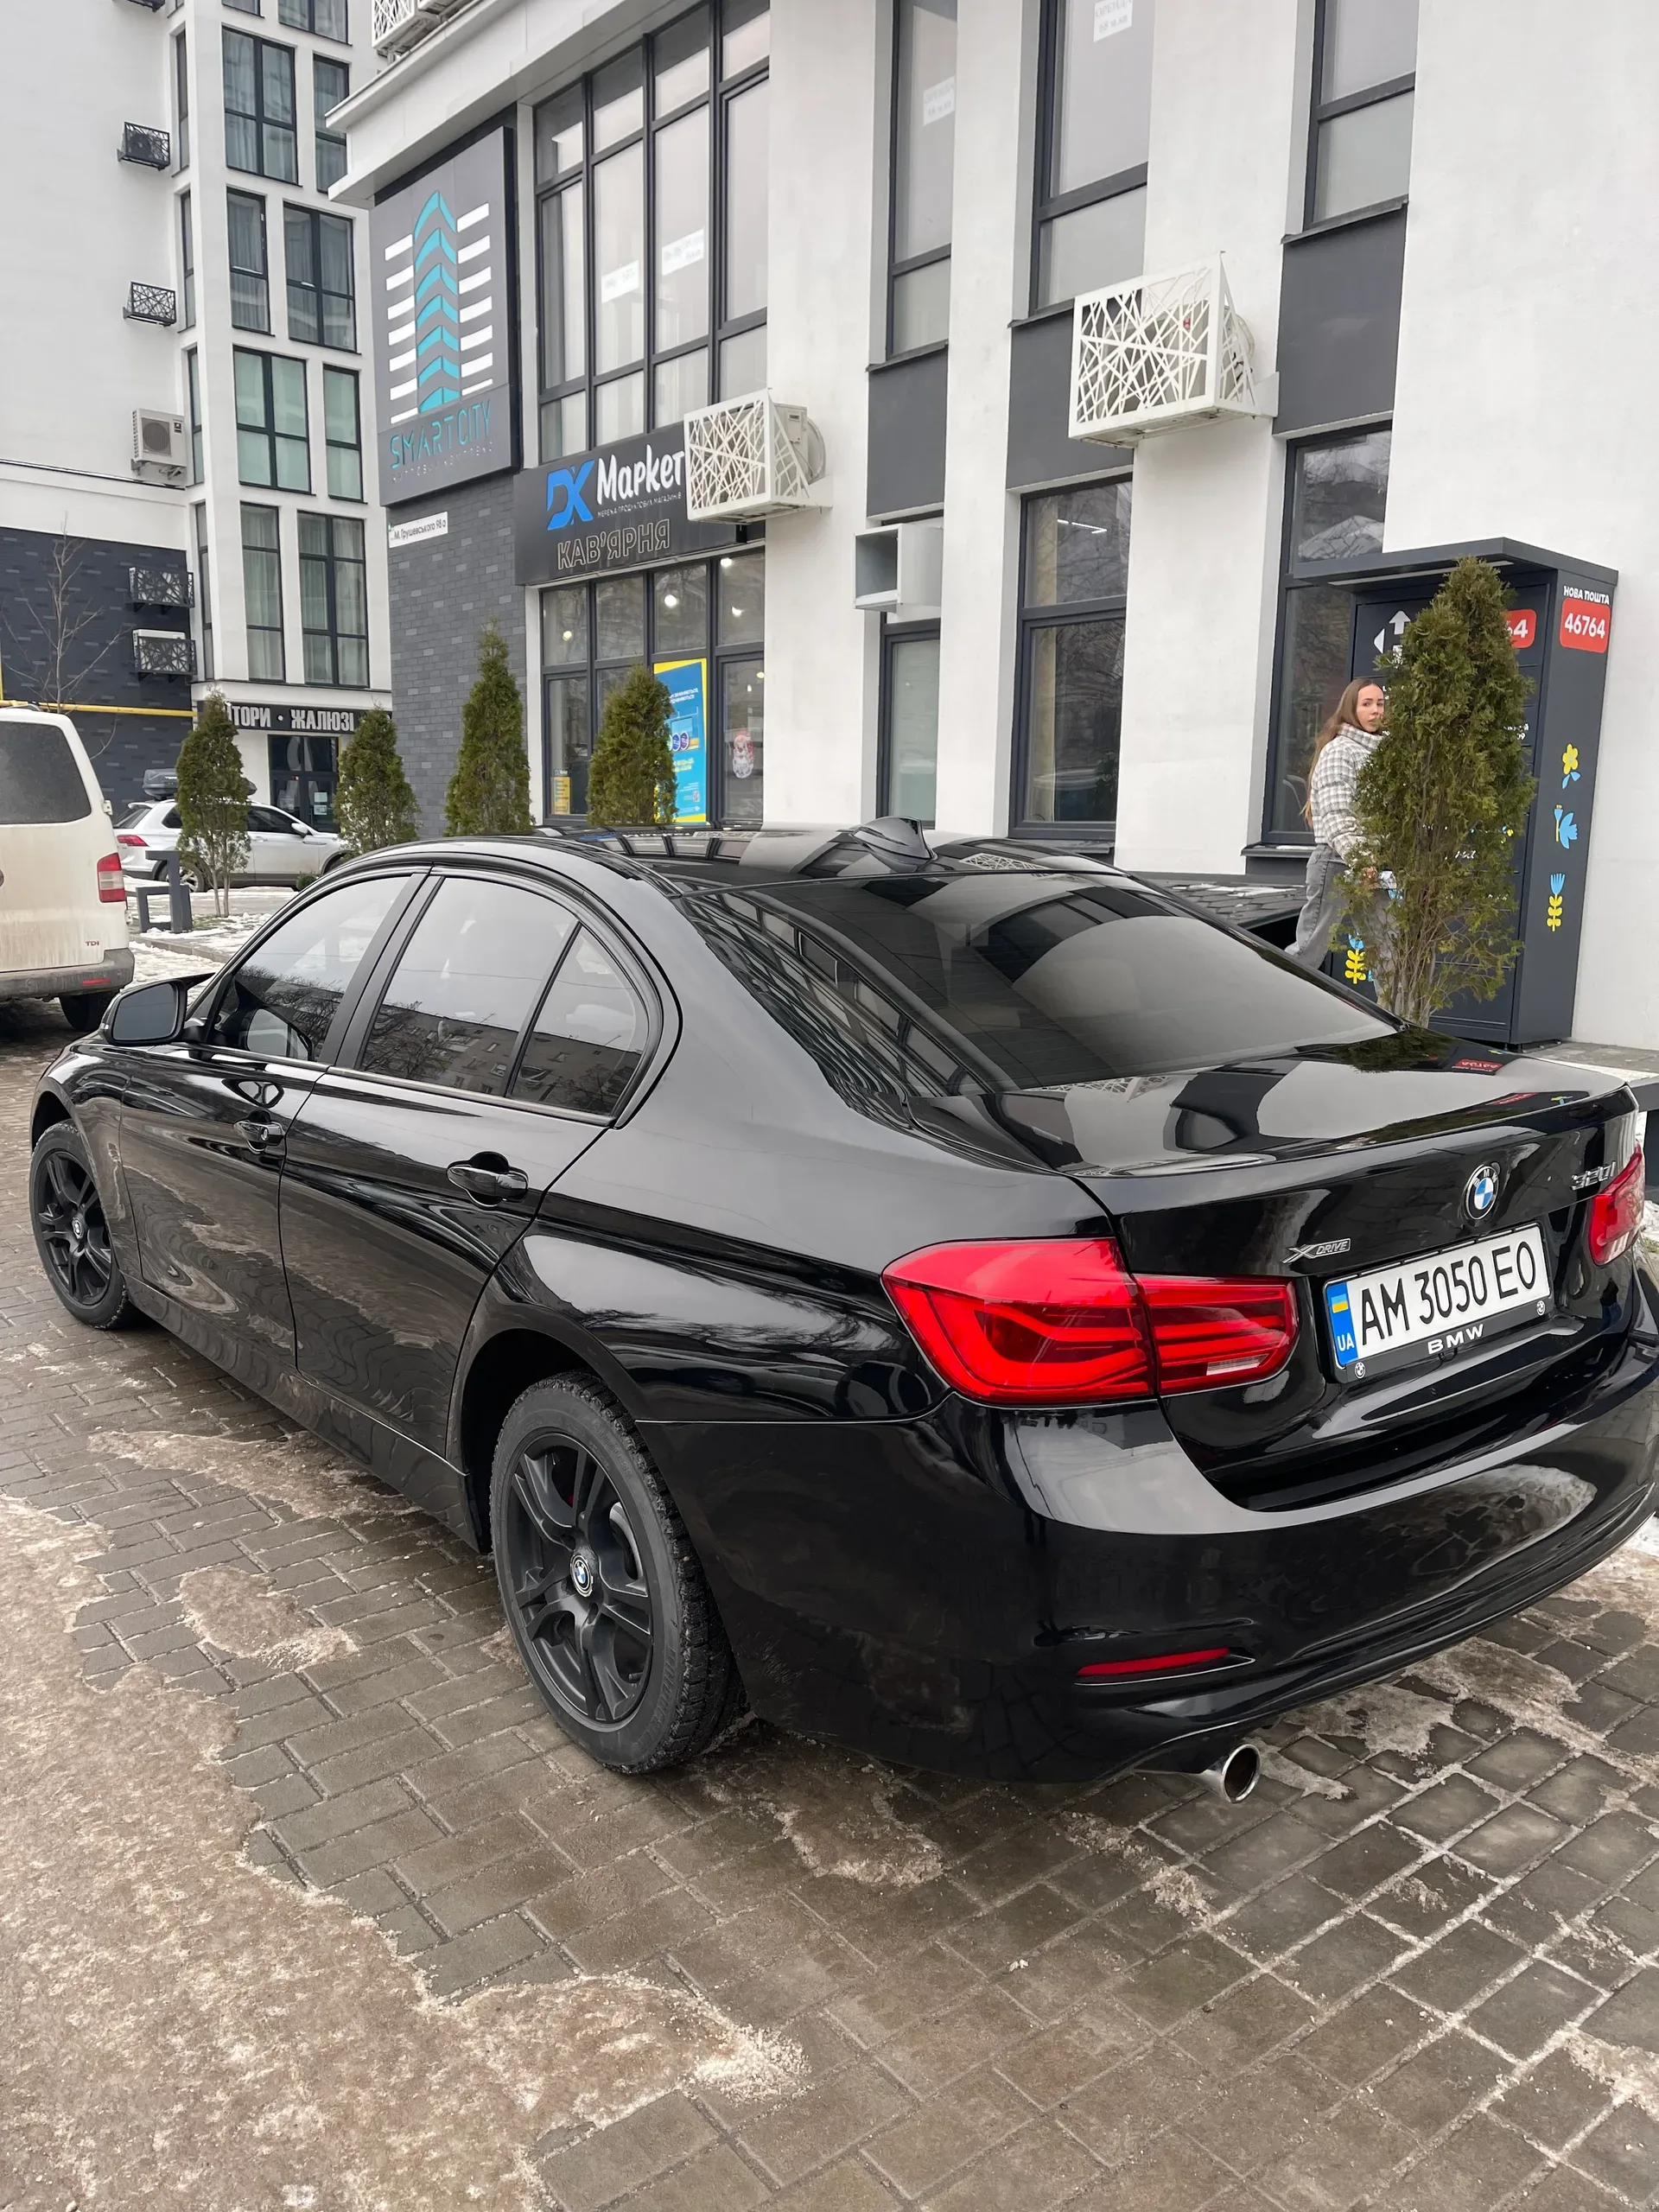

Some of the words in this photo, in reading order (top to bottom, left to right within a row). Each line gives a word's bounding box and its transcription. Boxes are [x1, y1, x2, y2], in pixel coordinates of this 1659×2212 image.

[596, 444, 685, 505] Маркет
[557, 518, 671, 570] КАВ'ЯРНЯ
[1563, 585, 1584, 600] НОВА
[1584, 590, 1610, 605] ПОШТА
[1564, 612, 1605, 639] 46764
[290, 709, 354, 732] ЖАЛЮЗІ
[1362, 1278, 1410, 1346] AM
[1414, 1255, 1489, 1325] 3050
[1491, 1241, 1536, 1298] EO
[1336, 1336, 1355, 1351] UA
[1427, 1324, 1484, 1355] BMW
